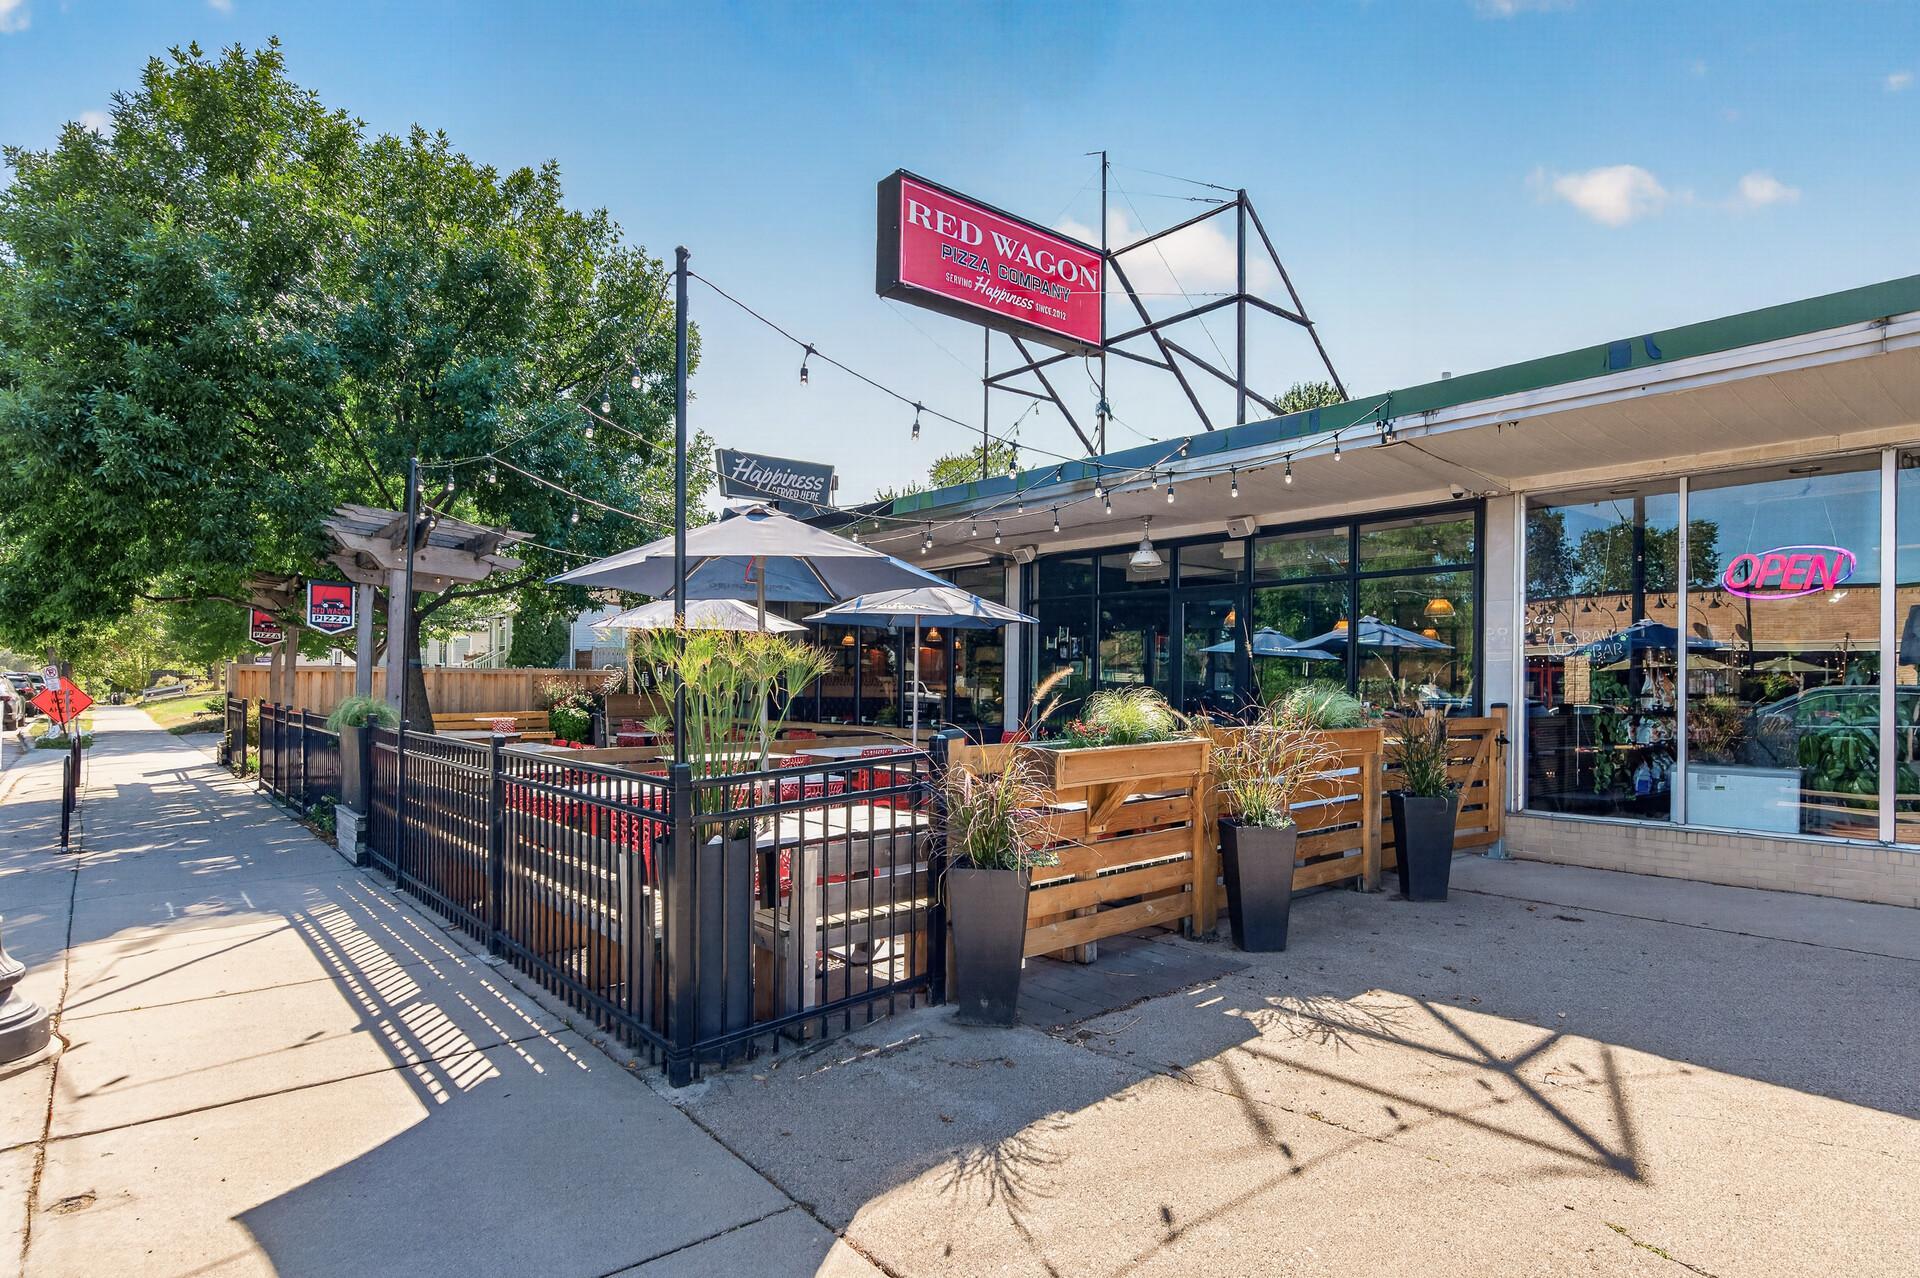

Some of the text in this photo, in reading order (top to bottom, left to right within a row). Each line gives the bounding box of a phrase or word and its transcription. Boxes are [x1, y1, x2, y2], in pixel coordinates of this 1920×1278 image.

[907, 198, 1098, 290] RED WAGON
[941, 243, 1071, 303] PIZZA COMPANY
[945, 273, 1067, 320] SERVING Happiness SINCE 2012
[732, 458, 824, 492] Happiness
[772, 488, 819, 501] SERVED HERE
[1724, 553, 1844, 591] OPEN
[1583, 630, 1614, 642] RAW
[1592, 643, 1623, 657] BAR
